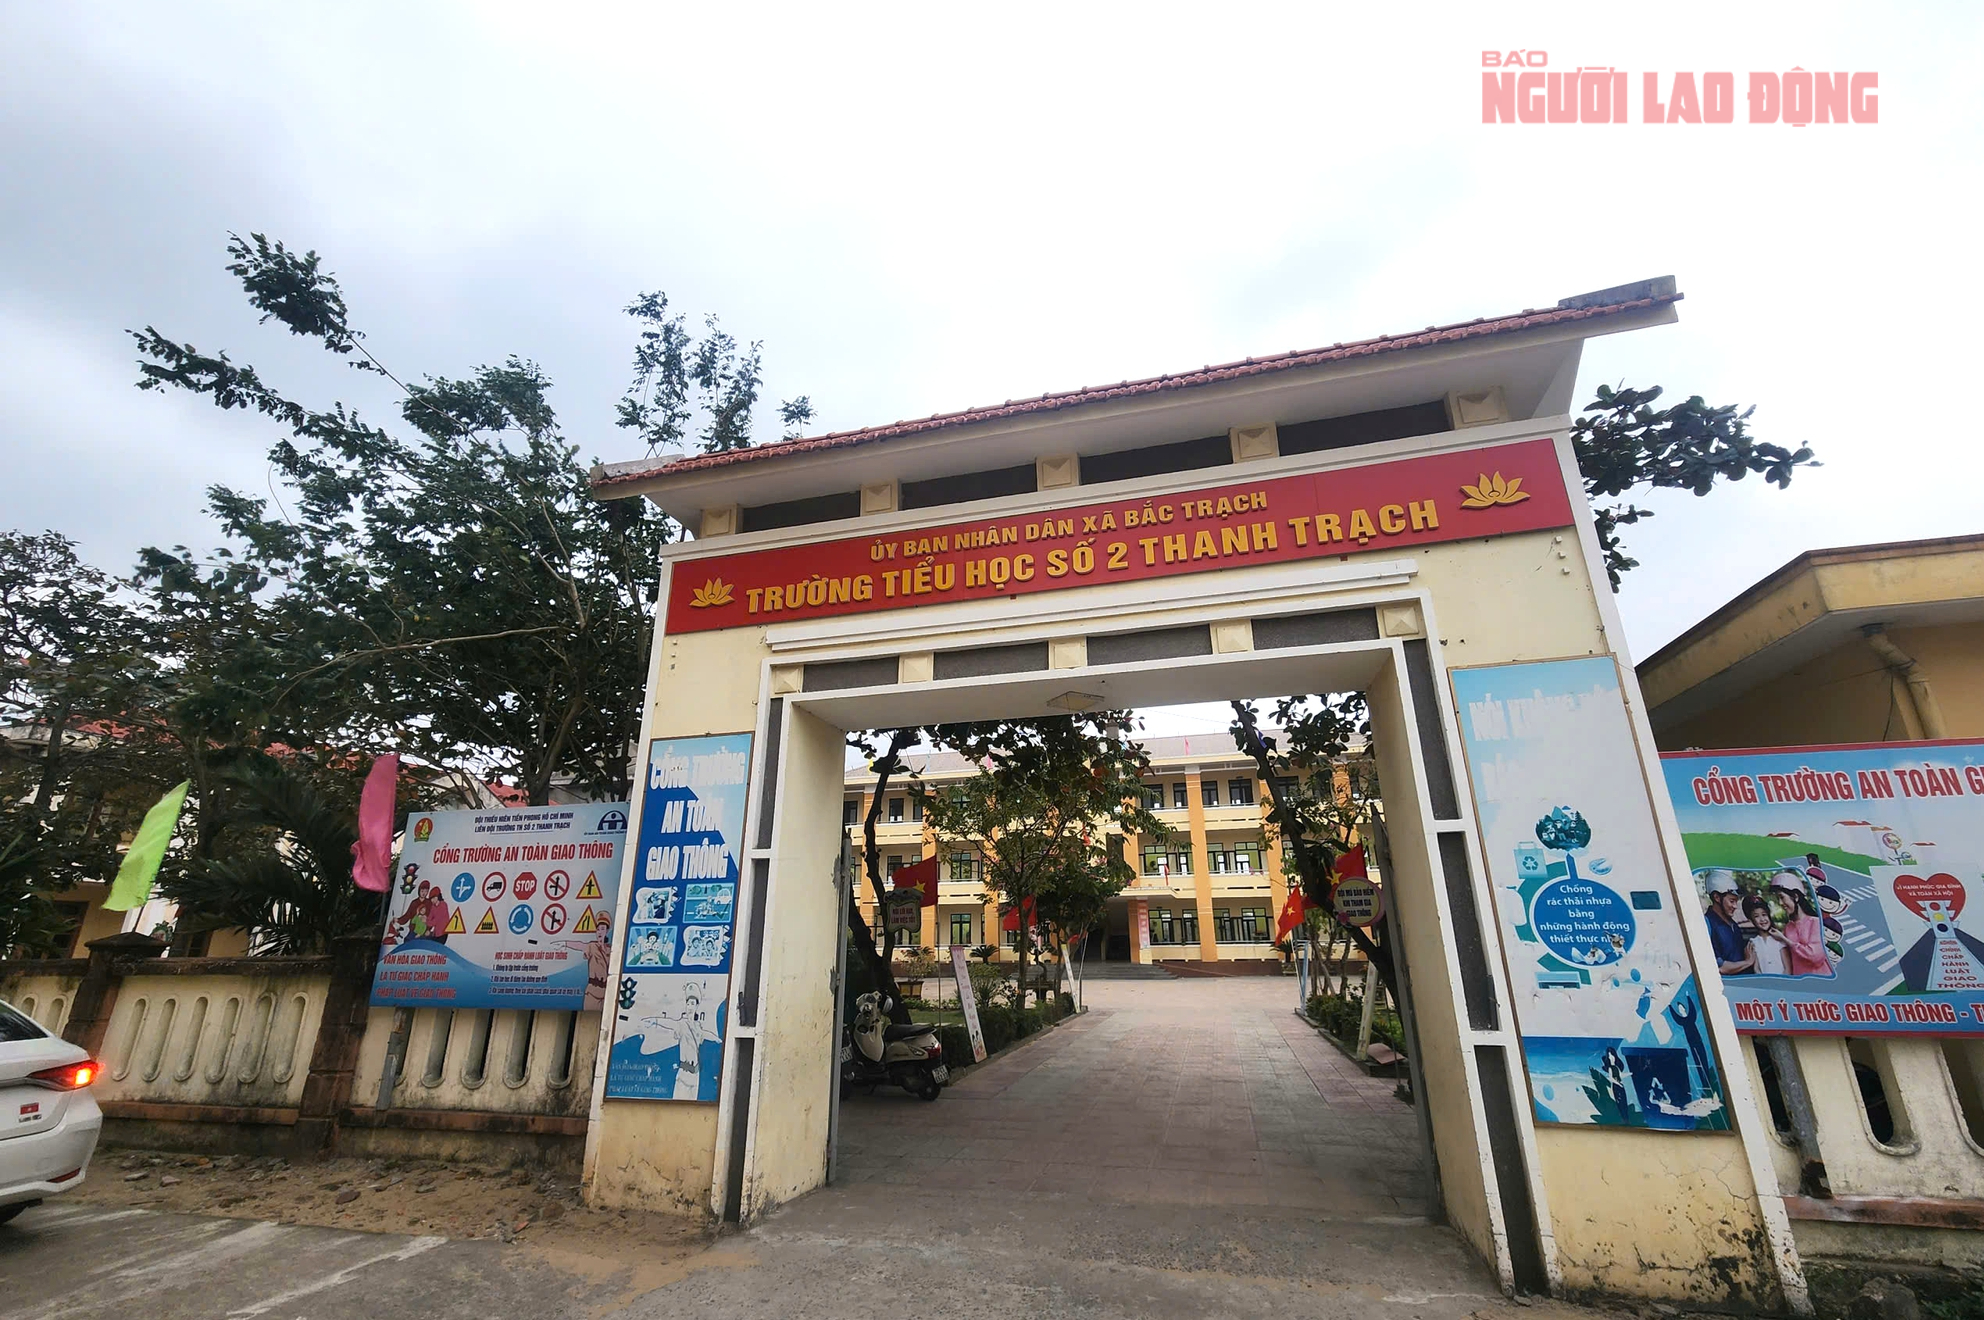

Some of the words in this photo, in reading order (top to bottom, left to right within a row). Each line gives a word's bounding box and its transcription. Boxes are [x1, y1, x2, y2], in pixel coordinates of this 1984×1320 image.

[870, 539, 897, 562] ỦY
[903, 535, 949, 558] BAN
[954, 526, 1018, 551] NHÂN
[1025, 515, 1074, 542] DÂN
[1082, 508, 1117, 533] XÃ
[1124, 500, 1174, 529] BẮC
[1181, 491, 1268, 521] TRẠCH
[745, 573, 874, 614] TRƯỜNG
[882, 556, 956, 599] TIỂU
[965, 554, 1035, 590] HỌC
[1046, 537, 1096, 578] SỐ
[1106, 543, 1129, 571] 2
[1138, 521, 1278, 566] THANH
[1288, 499, 1441, 545] TRẠCH
[1693, 767, 1758, 806] CỔNG
[1759, 766, 1853, 804] TRƯỜNG
[1860, 771, 1894, 799] AN
[1893, 763, 1964, 798] TOÀN
[660, 800, 685, 834] AN
[433, 843, 460, 864] CỔNG
[462, 843, 501, 863] TRƯỜNG
[503, 846, 518, 862] AN
[521, 842, 549, 861] TOÀN
[551, 844, 575, 860] GIAO
[578, 840, 613, 859] THÔNG
[646, 846, 680, 881] GIAO
[681, 837, 729, 880] THÔNG
[515, 878, 535, 892] STOP
[1560, 884, 1593, 895] Chống
[1547, 897, 1562, 906] rác
[1563, 896, 1584, 906] thải
[1585, 896, 1612, 908] nhựa
[1568, 907, 1595, 919] bằng
[1540, 922, 1573, 932] những
[1574, 921, 1601, 931] hành
[1602, 921, 1630, 932] động
[1550, 933, 1574, 943] thiết
[1576, 934, 1599, 945] thực
[1945, 967, 1970, 975] LUẬT
[1735, 999, 1774, 1025] MỘT
[1777, 999, 1789, 1021] Ý
[1793, 999, 1841, 1022] THỨC
[1845, 1003, 1889, 1022] GIAO
[1891, 1000, 1957, 1022] THÔNG
